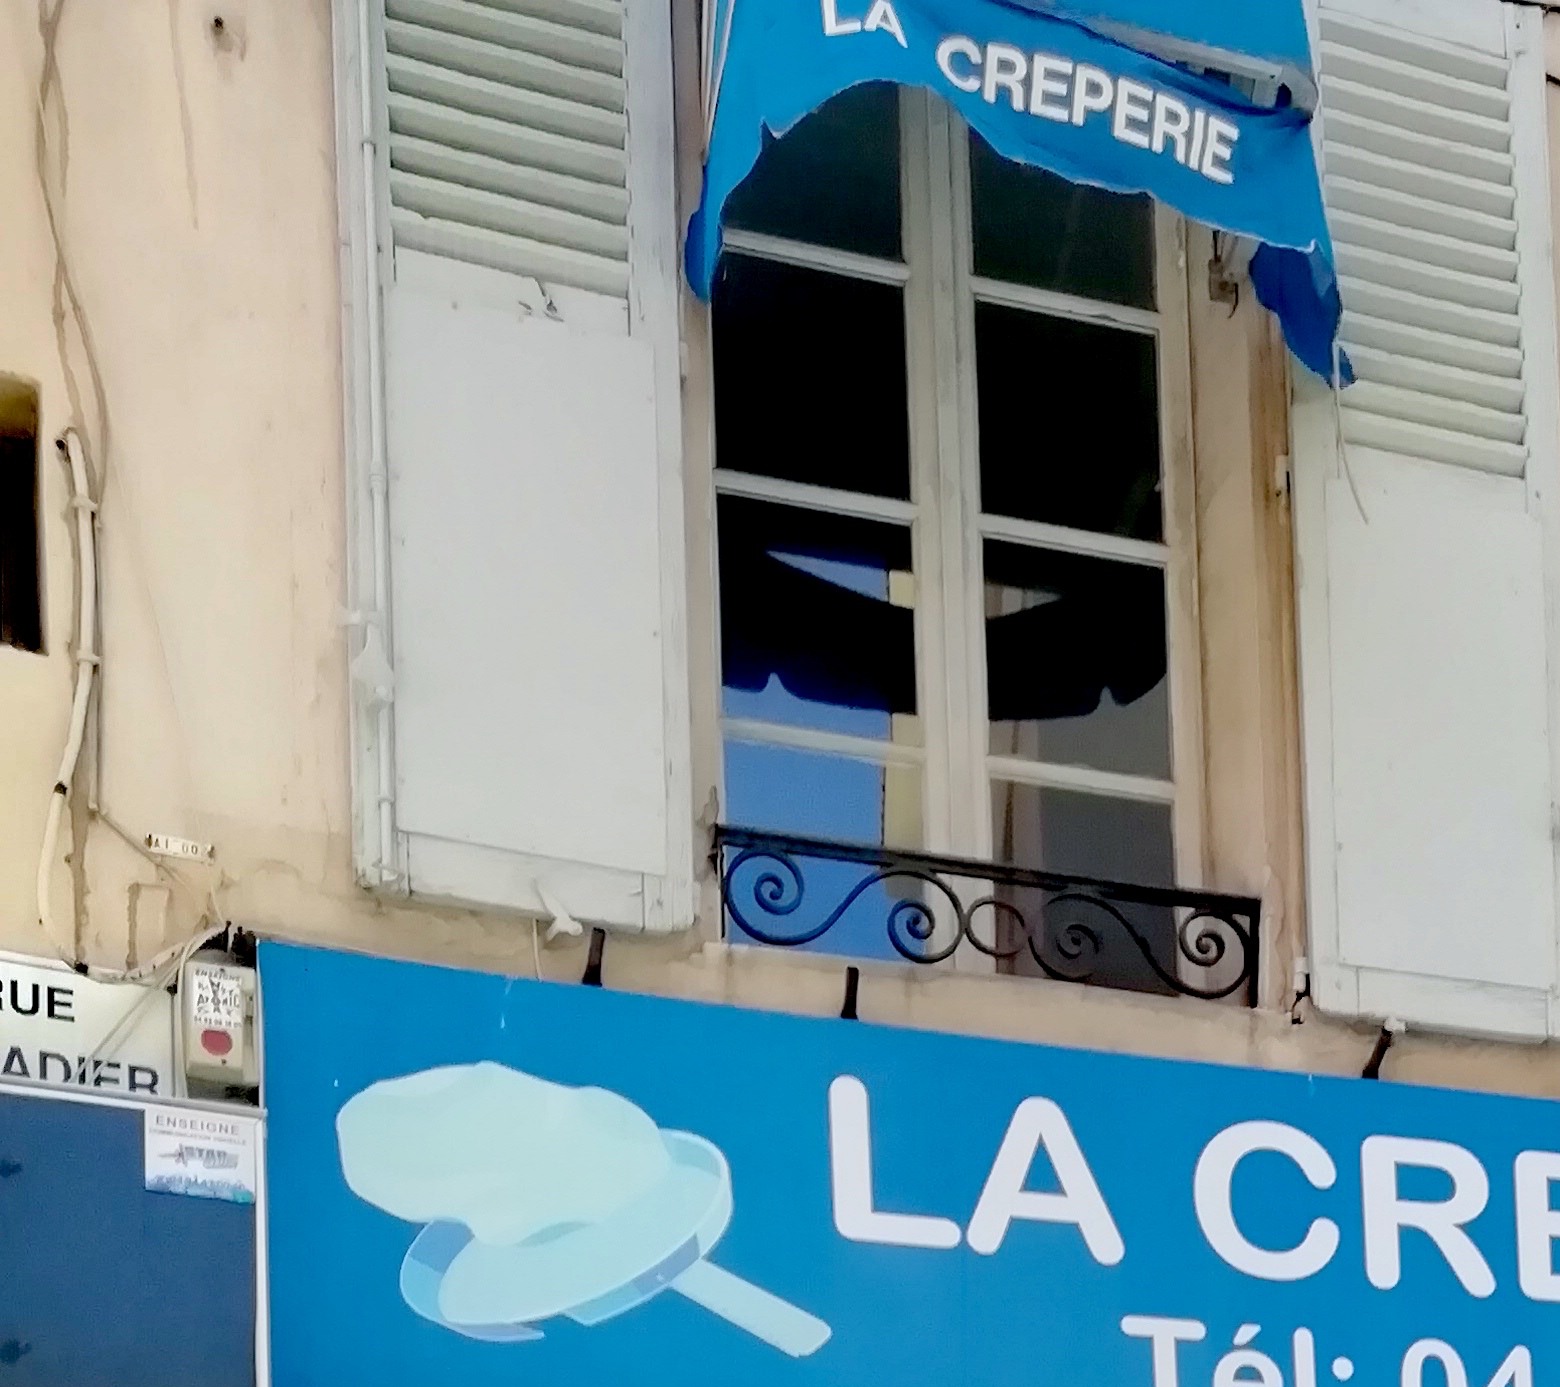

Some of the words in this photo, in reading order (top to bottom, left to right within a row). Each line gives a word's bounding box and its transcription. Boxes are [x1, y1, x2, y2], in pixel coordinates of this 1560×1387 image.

[937, 38, 1238, 183] CREPERIE
[0, 979, 76, 1023] UE
[830, 1076, 1124, 1264] LA
